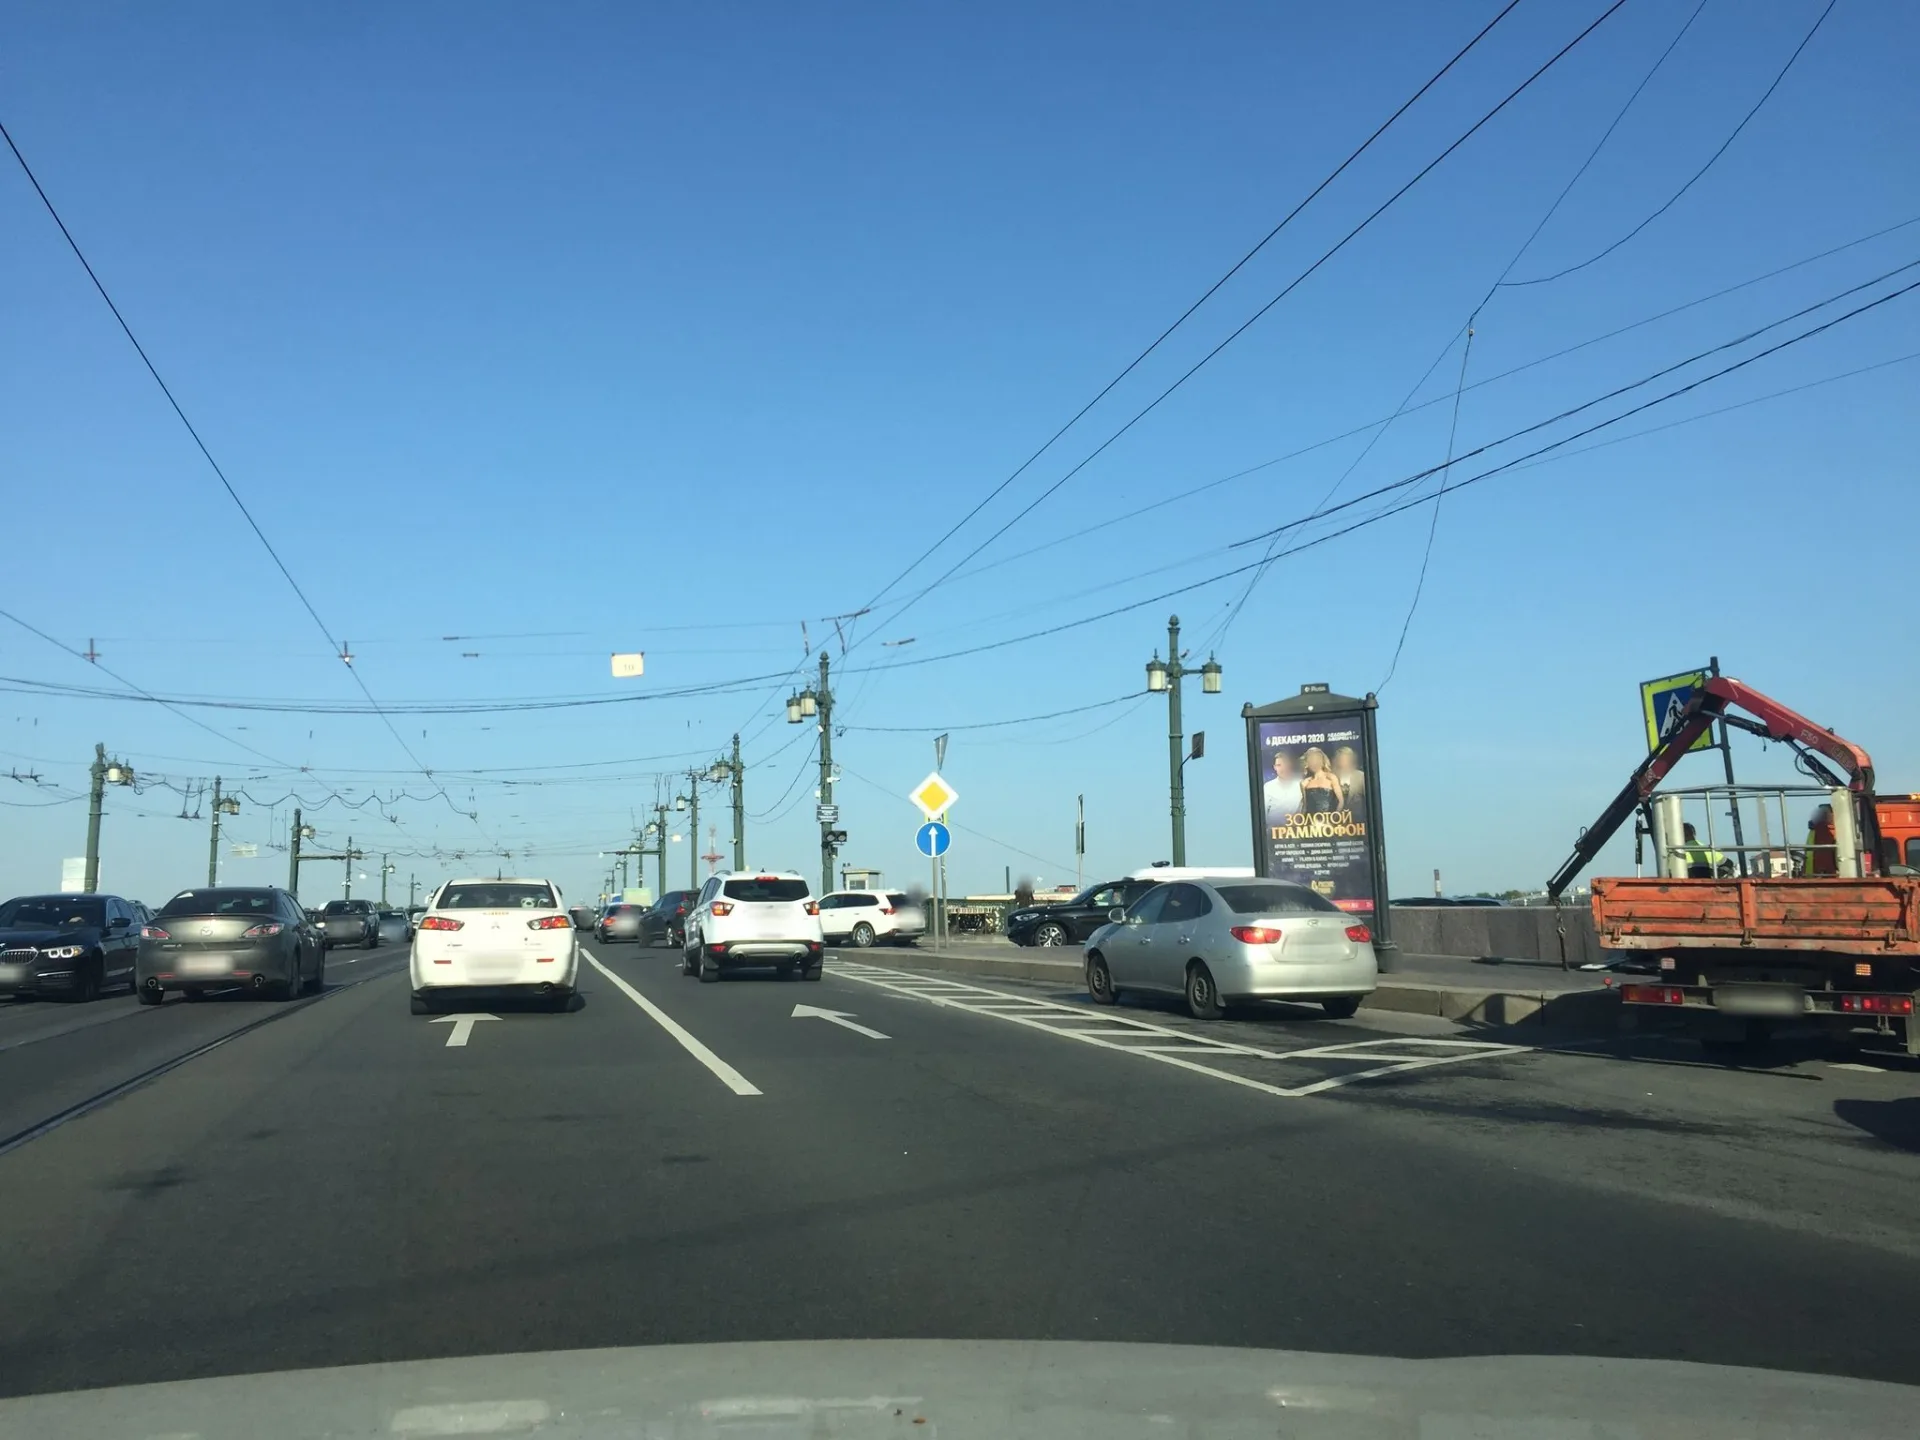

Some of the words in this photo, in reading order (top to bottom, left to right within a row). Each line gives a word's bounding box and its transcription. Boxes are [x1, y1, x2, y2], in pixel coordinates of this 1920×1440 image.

[1266, 737, 1271, 746] 6
[1271, 735, 1307, 747] ДЕКАБРЯ
[1308, 733, 1325, 743] 2020
[1284, 809, 1353, 826] ЗОЛОТОЙ
[1271, 823, 1365, 839] ГРАММОФОН
